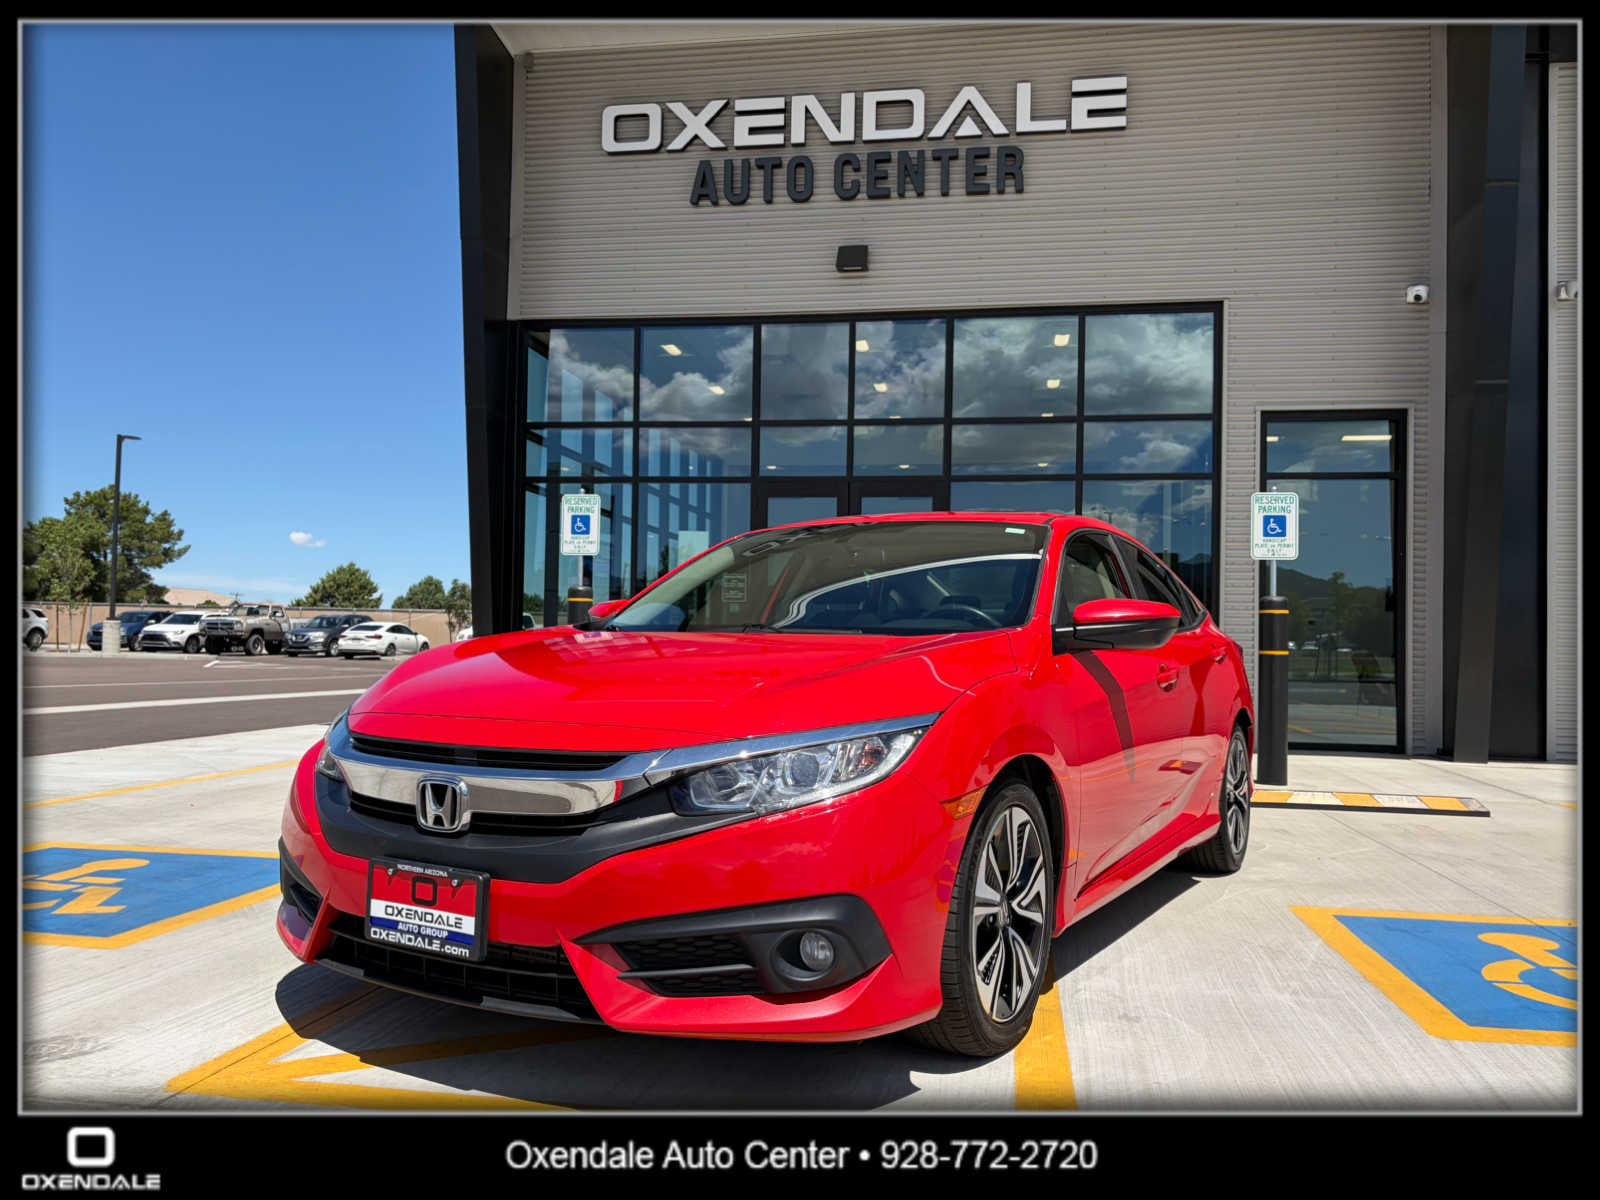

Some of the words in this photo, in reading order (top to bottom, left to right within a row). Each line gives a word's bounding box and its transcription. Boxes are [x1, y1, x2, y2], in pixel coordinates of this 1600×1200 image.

[601, 76, 1128, 153] OXENDALE
[690, 156, 814, 207] AUTO
[833, 146, 1025, 201] CENTER
[1255, 496, 1295, 505] RESERVED
[1257, 505, 1292, 514] PARKING
[384, 904, 463, 930] OXENDALE
[370, 928, 470, 957] OXENDALE.com
[398, 922, 418, 934] AUTO
[420, 925, 449, 939] GROUP
